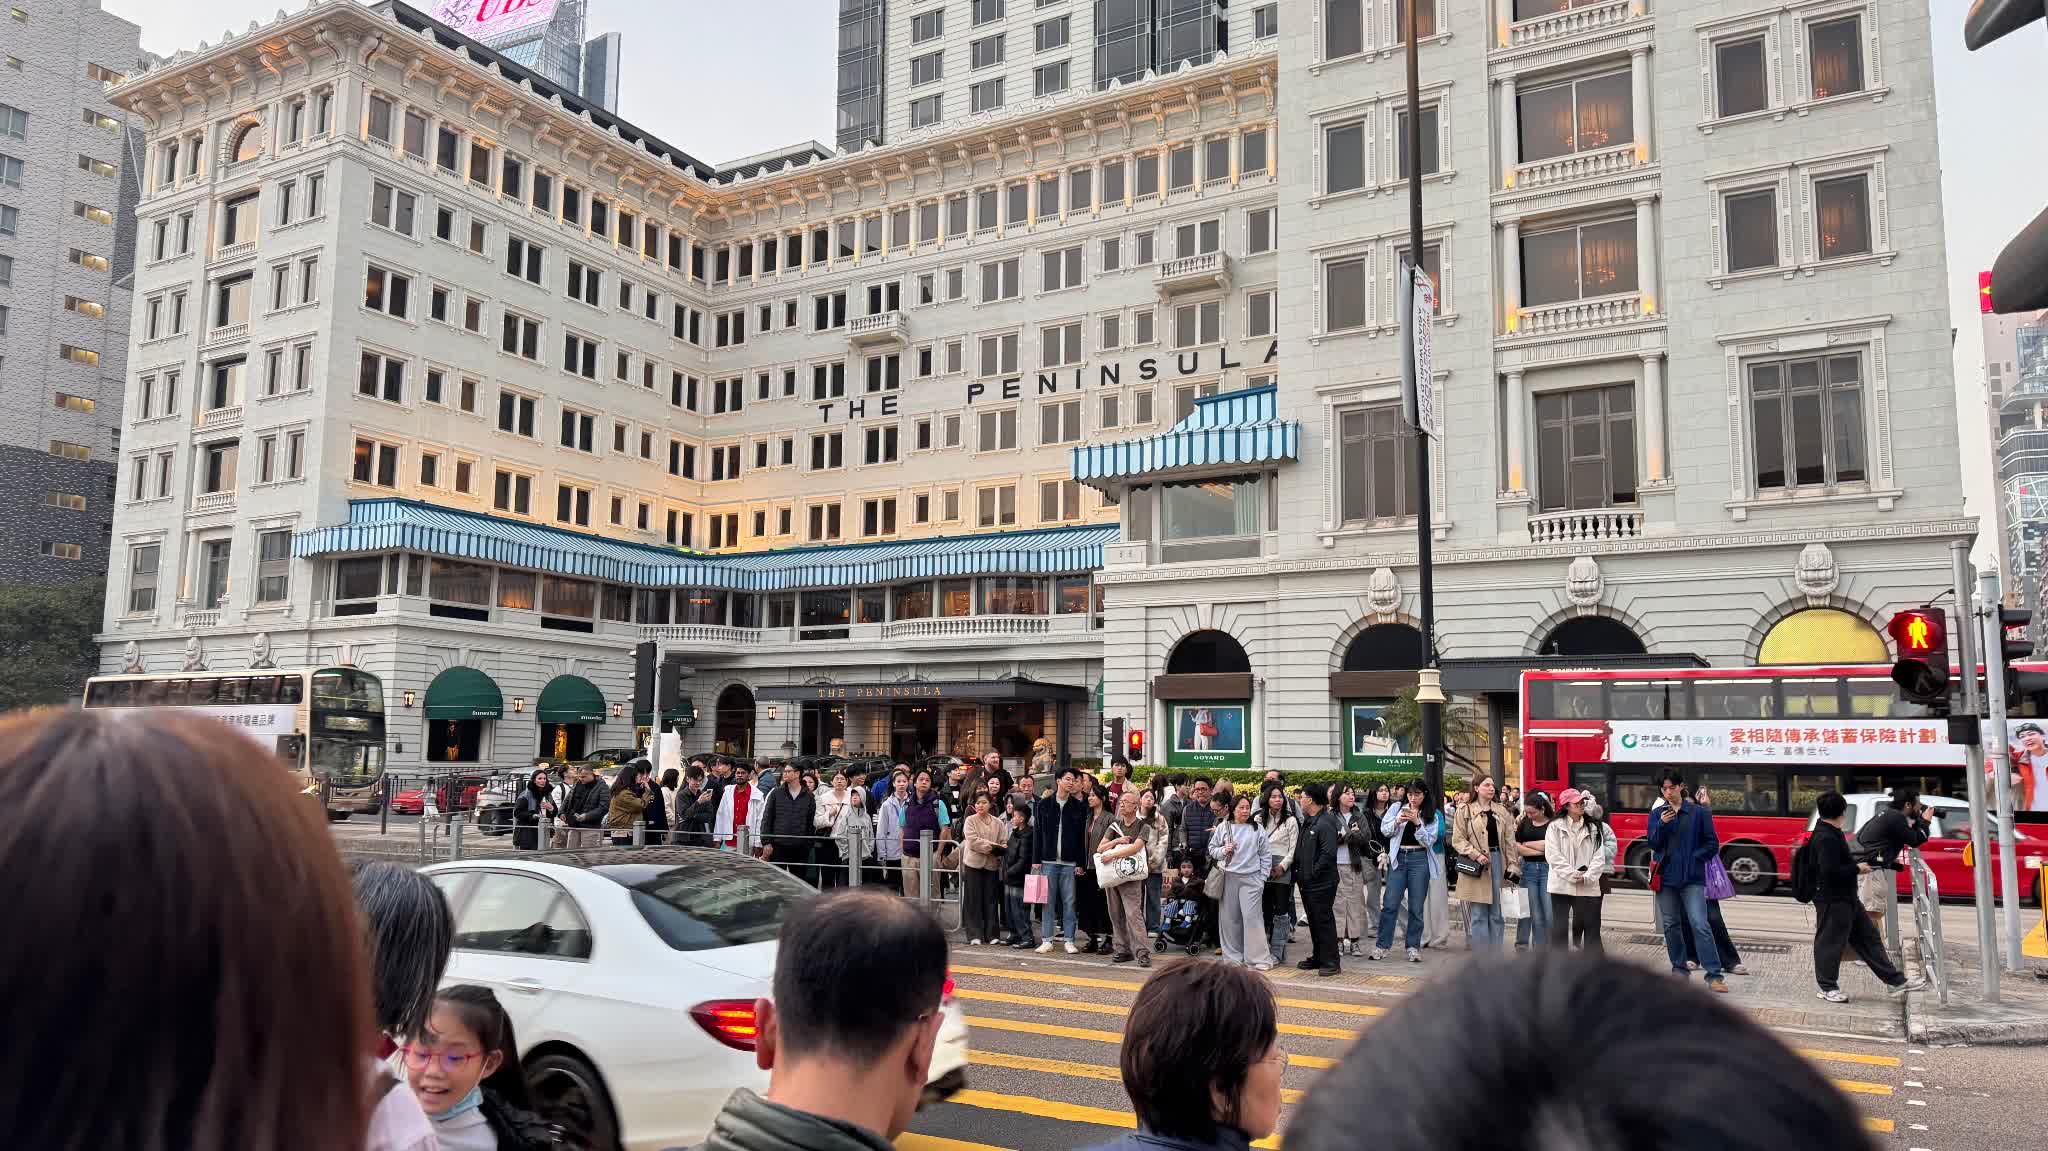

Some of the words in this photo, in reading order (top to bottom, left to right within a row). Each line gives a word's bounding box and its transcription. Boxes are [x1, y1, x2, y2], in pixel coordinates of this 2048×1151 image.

[819, 395, 898, 423] THE
[967, 340, 1278, 404] PENINSULA
[818, 688, 846, 698] THE
[857, 686, 942, 697] PENINSULA
